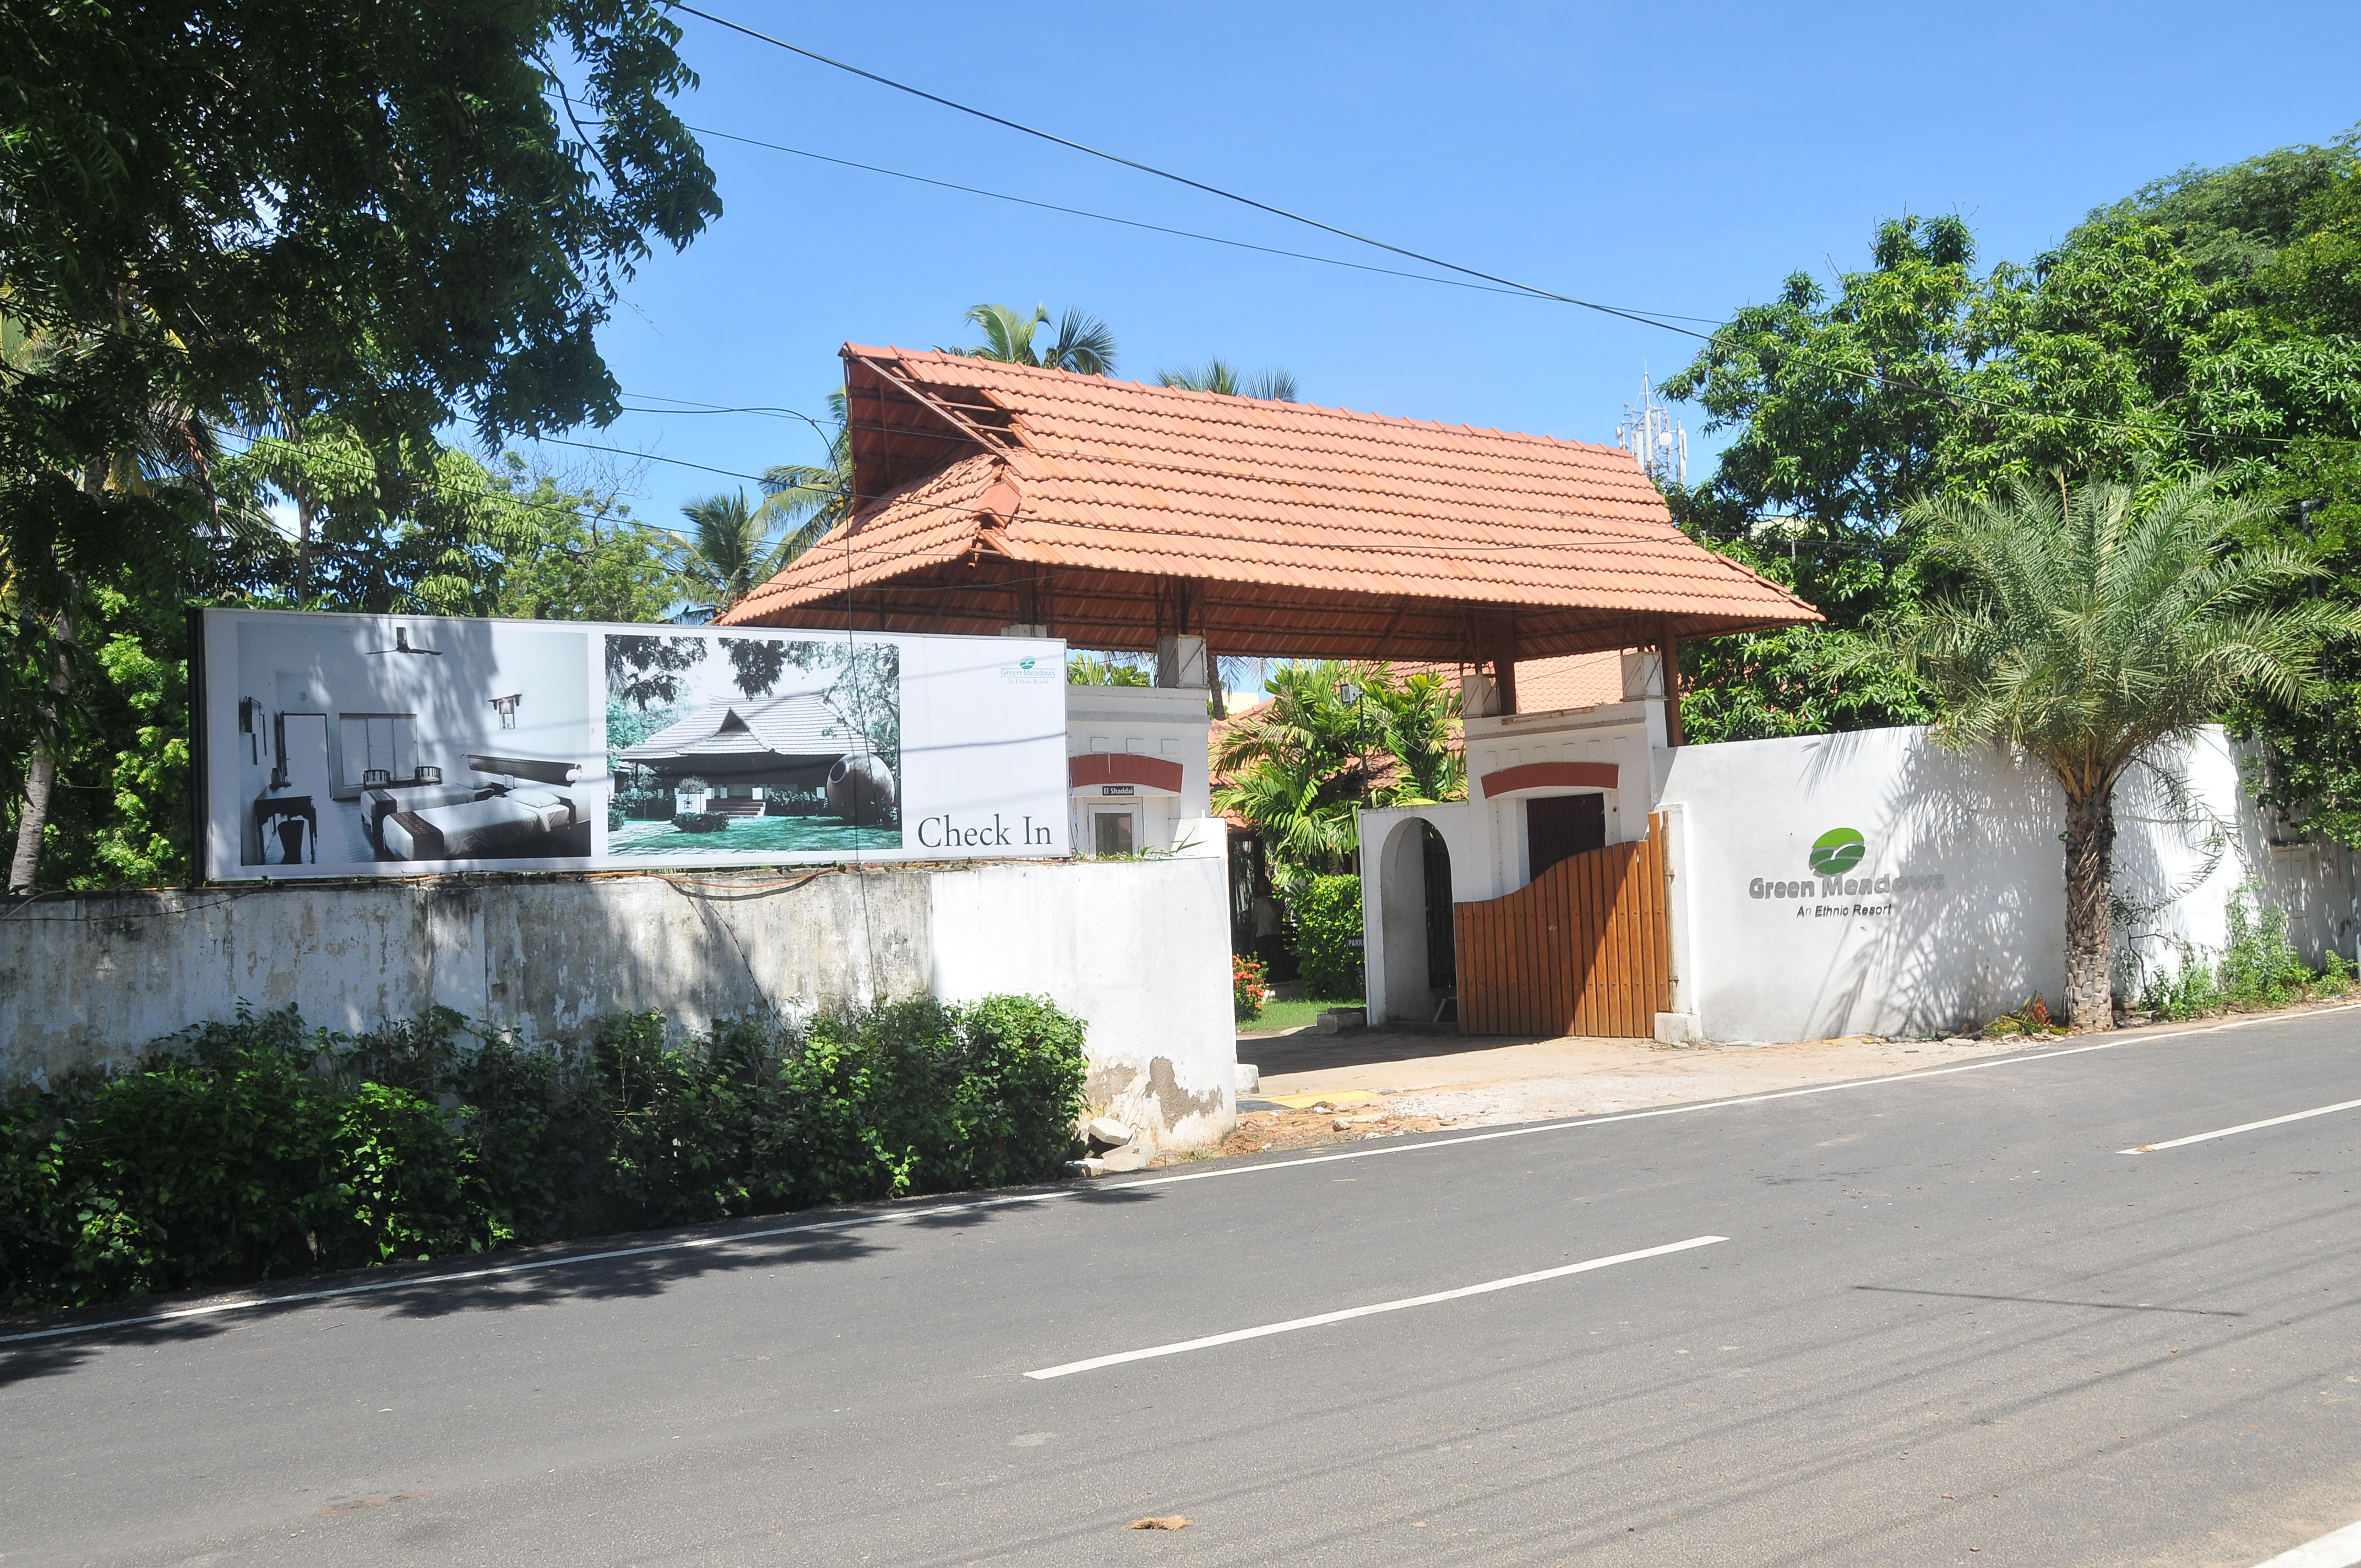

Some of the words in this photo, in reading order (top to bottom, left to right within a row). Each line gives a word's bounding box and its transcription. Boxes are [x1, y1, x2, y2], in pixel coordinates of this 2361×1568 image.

[918, 813, 1012, 848] Check
[1022, 816, 1053, 845] In
[1749, 878, 1814, 899] Green
[1822, 874, 1945, 898] Meadows
[1797, 906, 1811, 918] An
[1815, 905, 1849, 918] Ethnic
[1852, 903, 1892, 917] Resort
